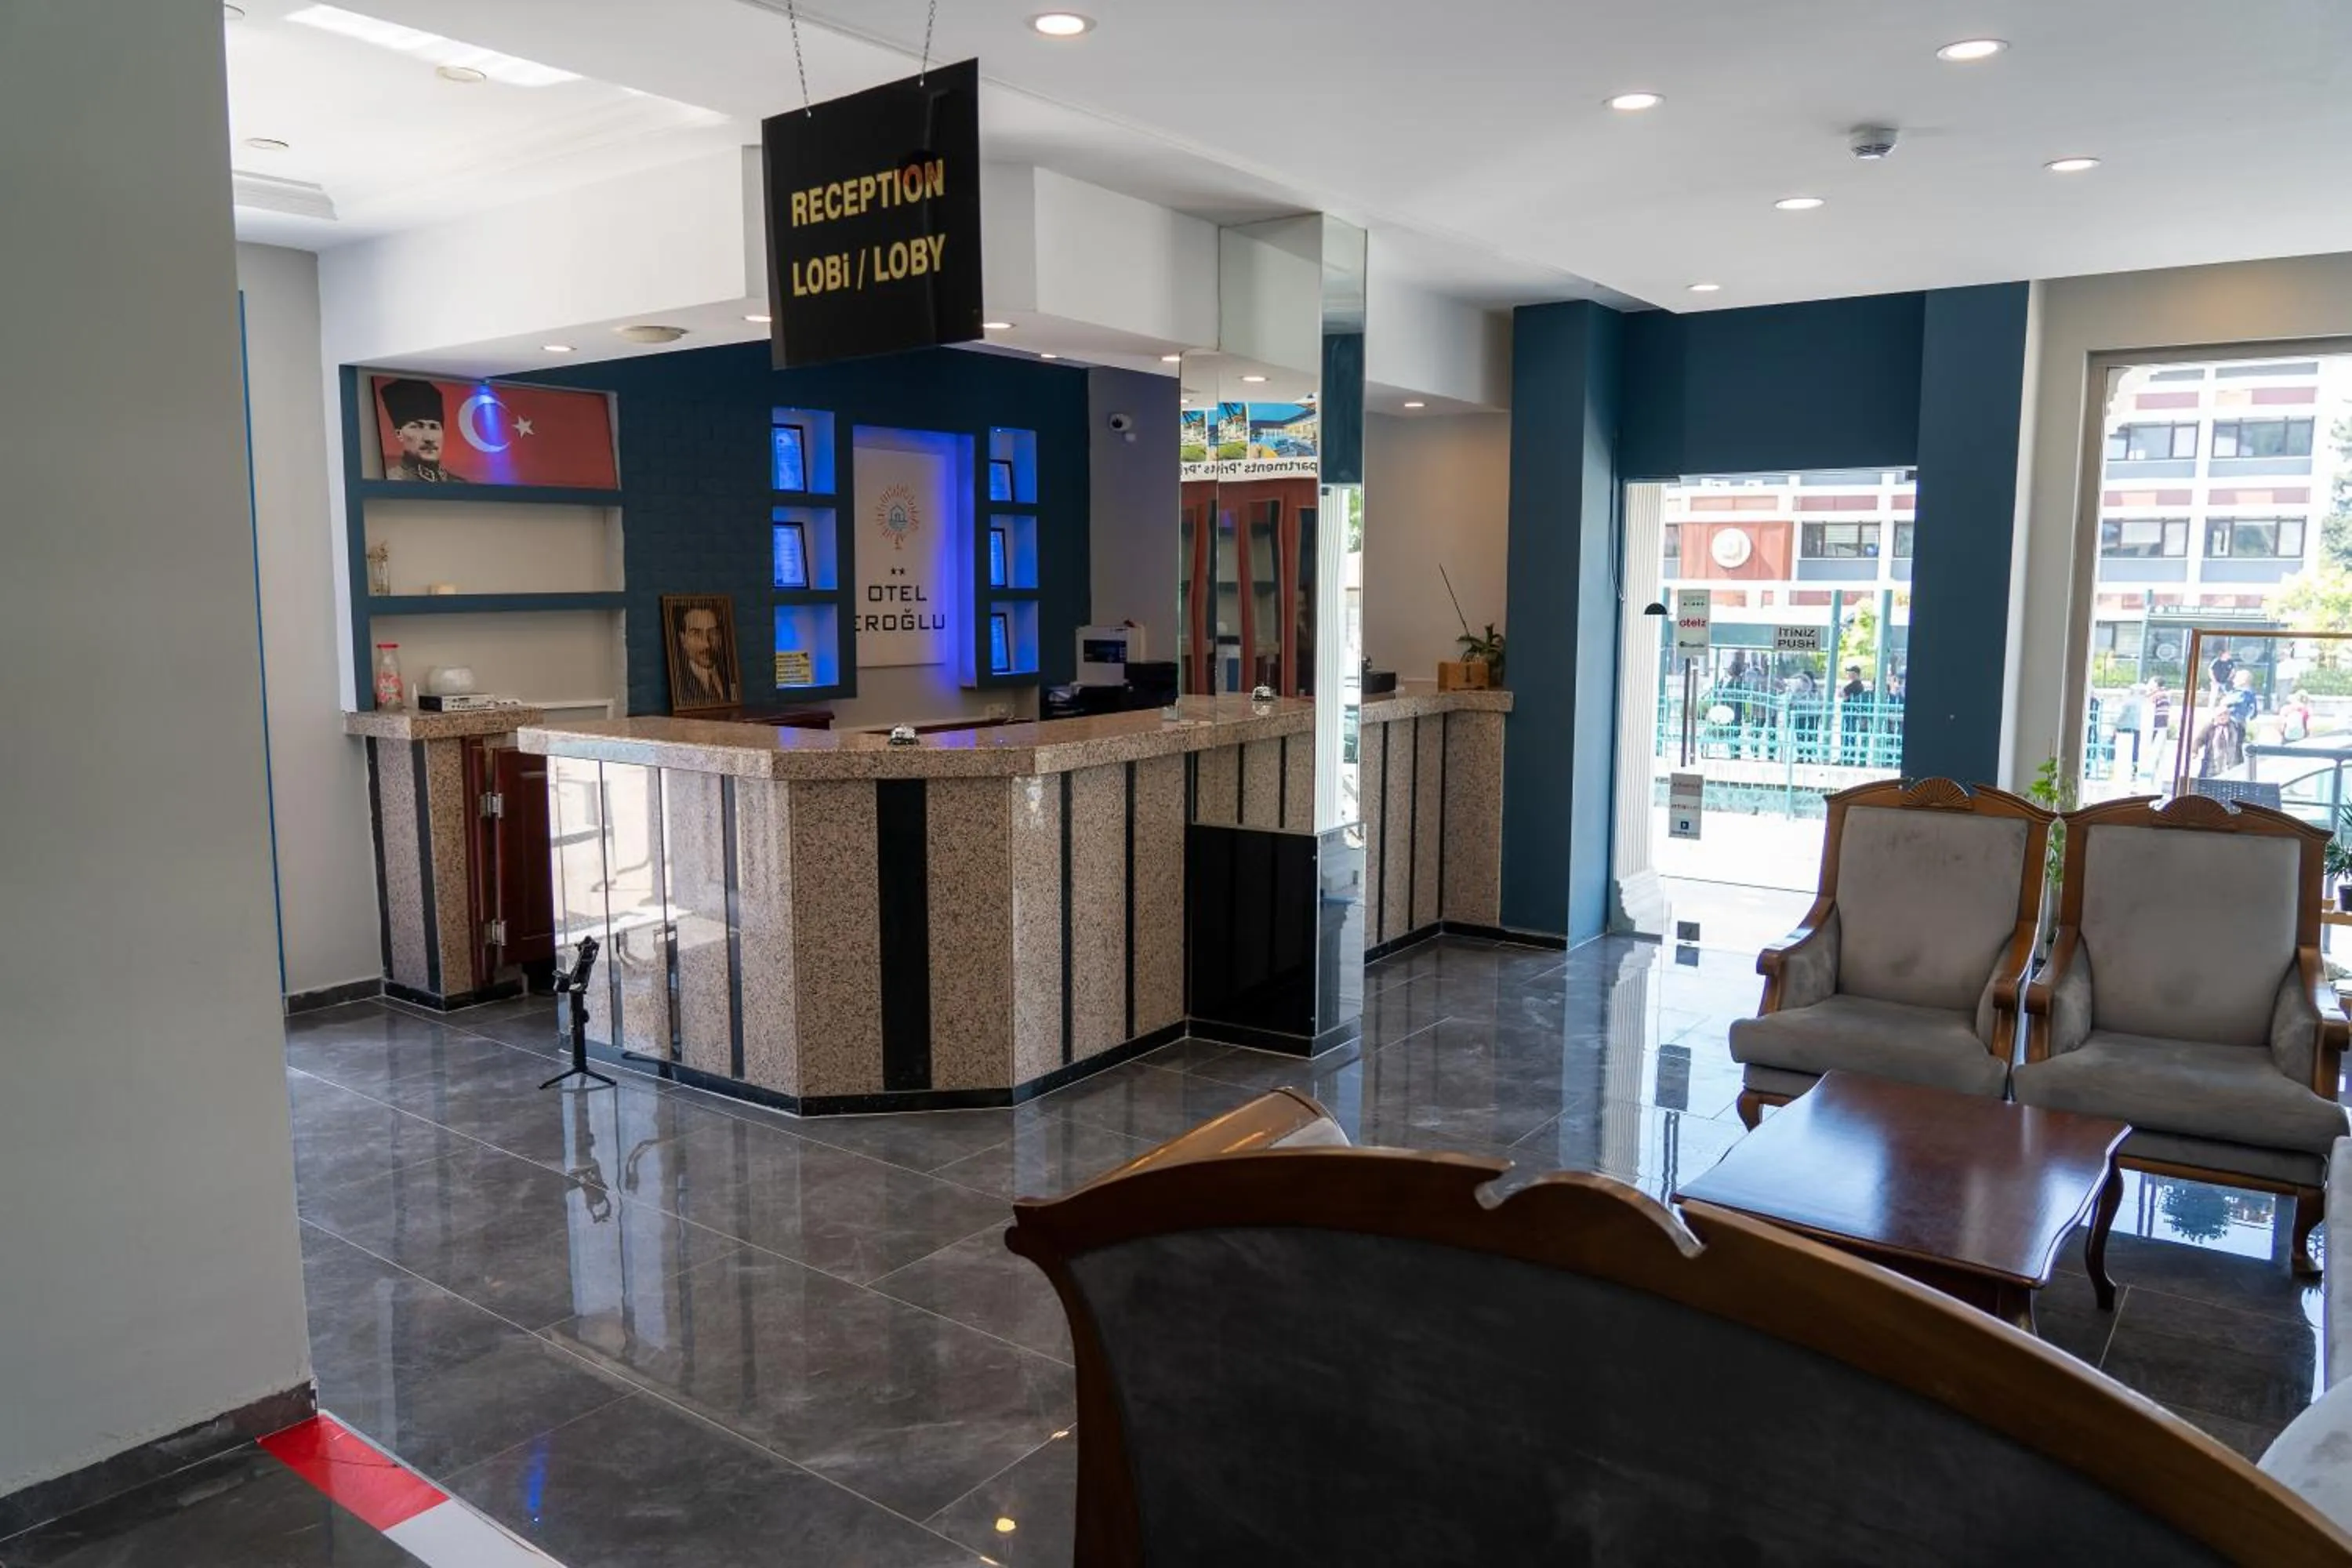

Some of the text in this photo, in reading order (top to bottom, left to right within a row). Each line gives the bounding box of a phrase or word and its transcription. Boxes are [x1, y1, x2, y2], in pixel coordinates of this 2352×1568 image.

[791, 159, 944, 227] RECEPTION
[874, 234, 946, 282] LOBY
[868, 585, 927, 601] OTEL
[1777, 639, 1815, 648] PUSH
